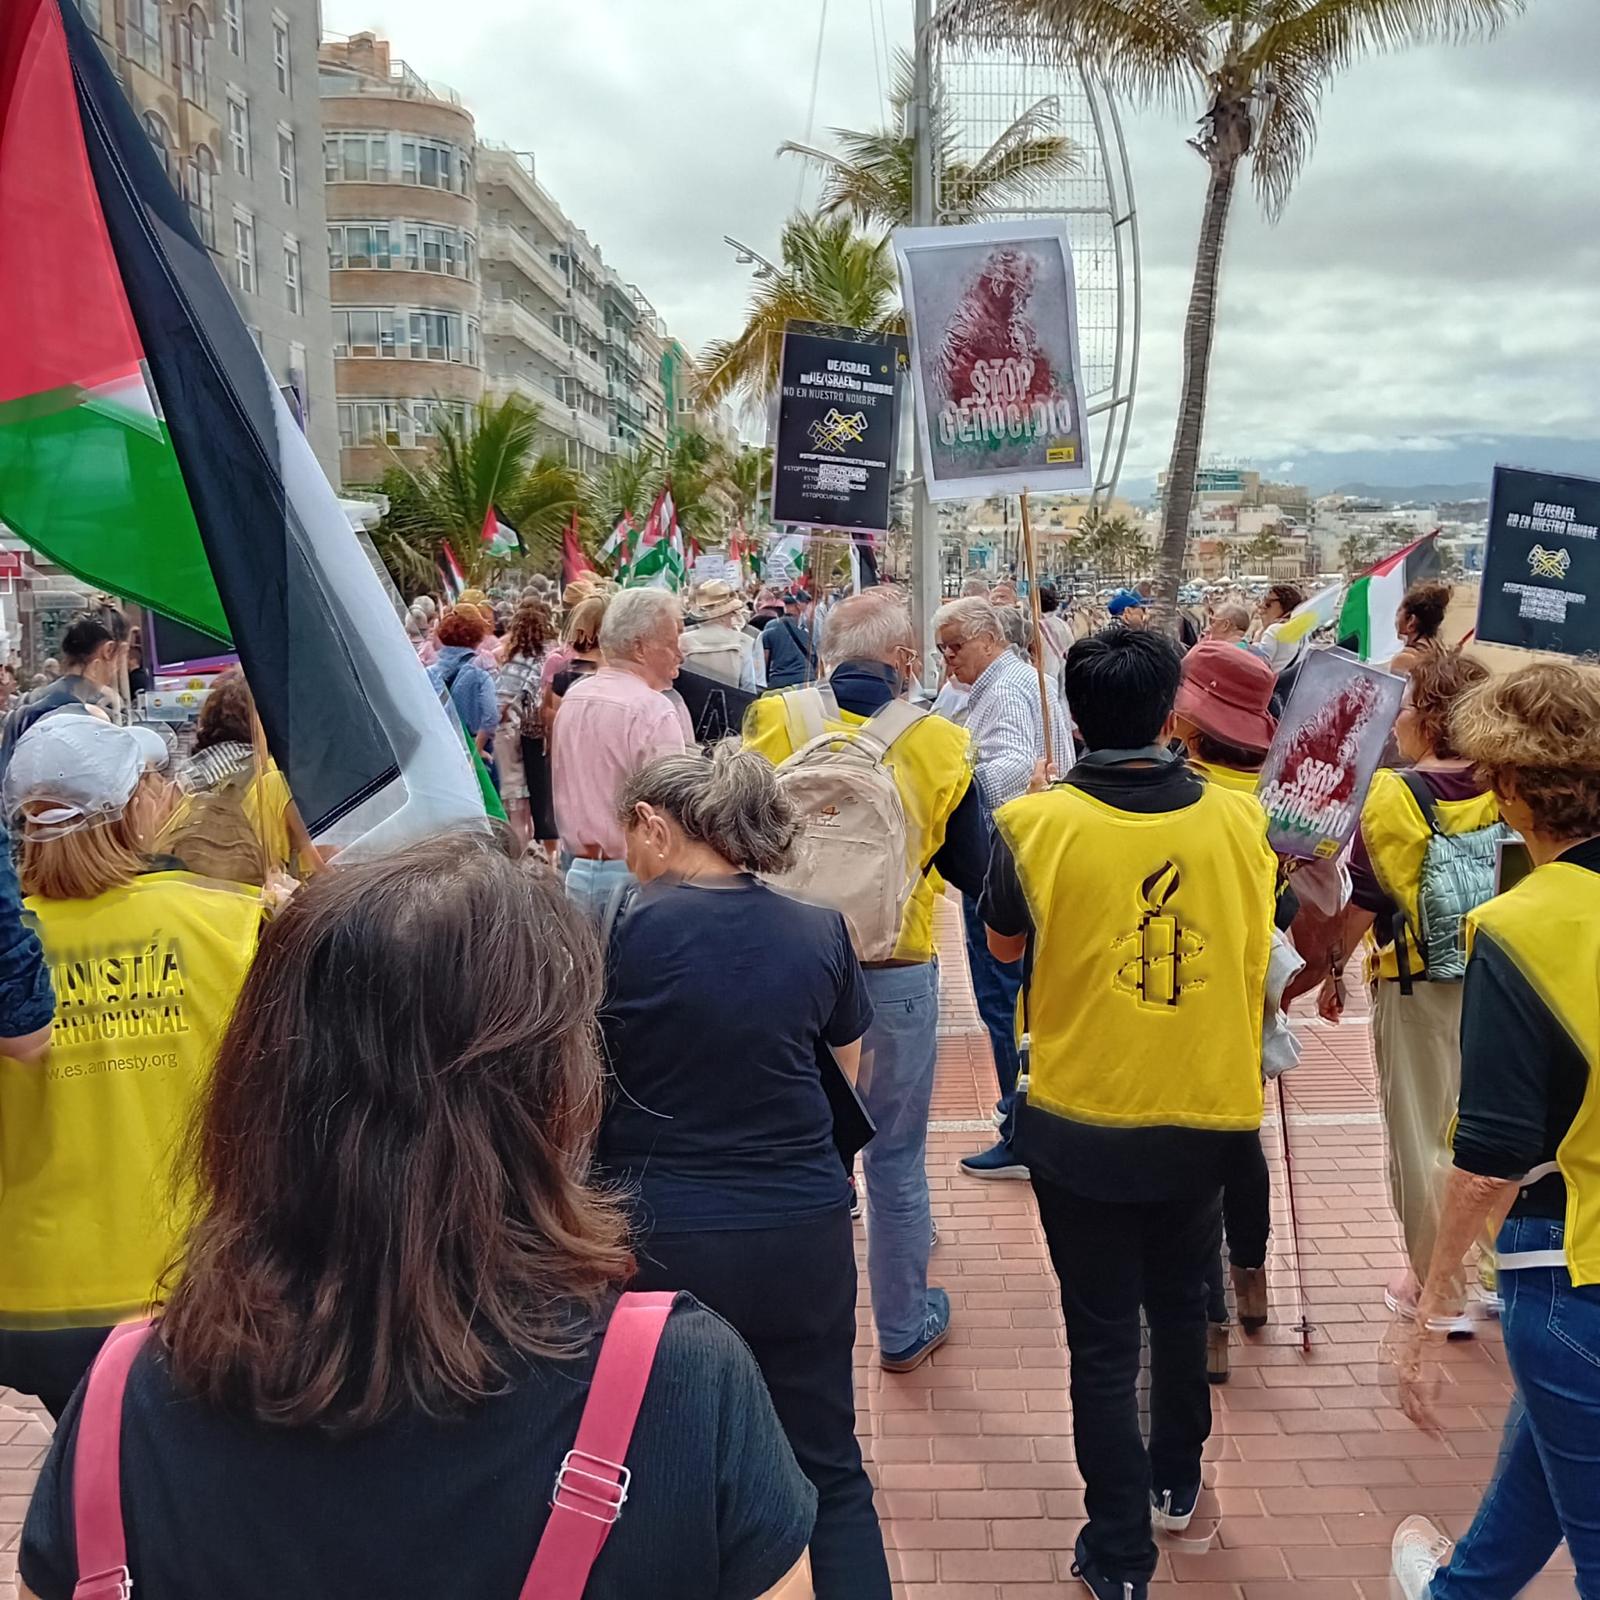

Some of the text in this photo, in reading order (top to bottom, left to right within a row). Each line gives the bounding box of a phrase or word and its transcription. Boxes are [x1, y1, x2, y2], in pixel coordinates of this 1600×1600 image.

[783, 386, 877, 406] NO EN NUESTRO NOMBRE
[970, 363, 1033, 404] STOP
[54, 944, 185, 1008] NISTÍA
[51, 1004, 189, 1047] RNACIONAL
[48, 1052, 178, 1080] w.es.amnesty.org
